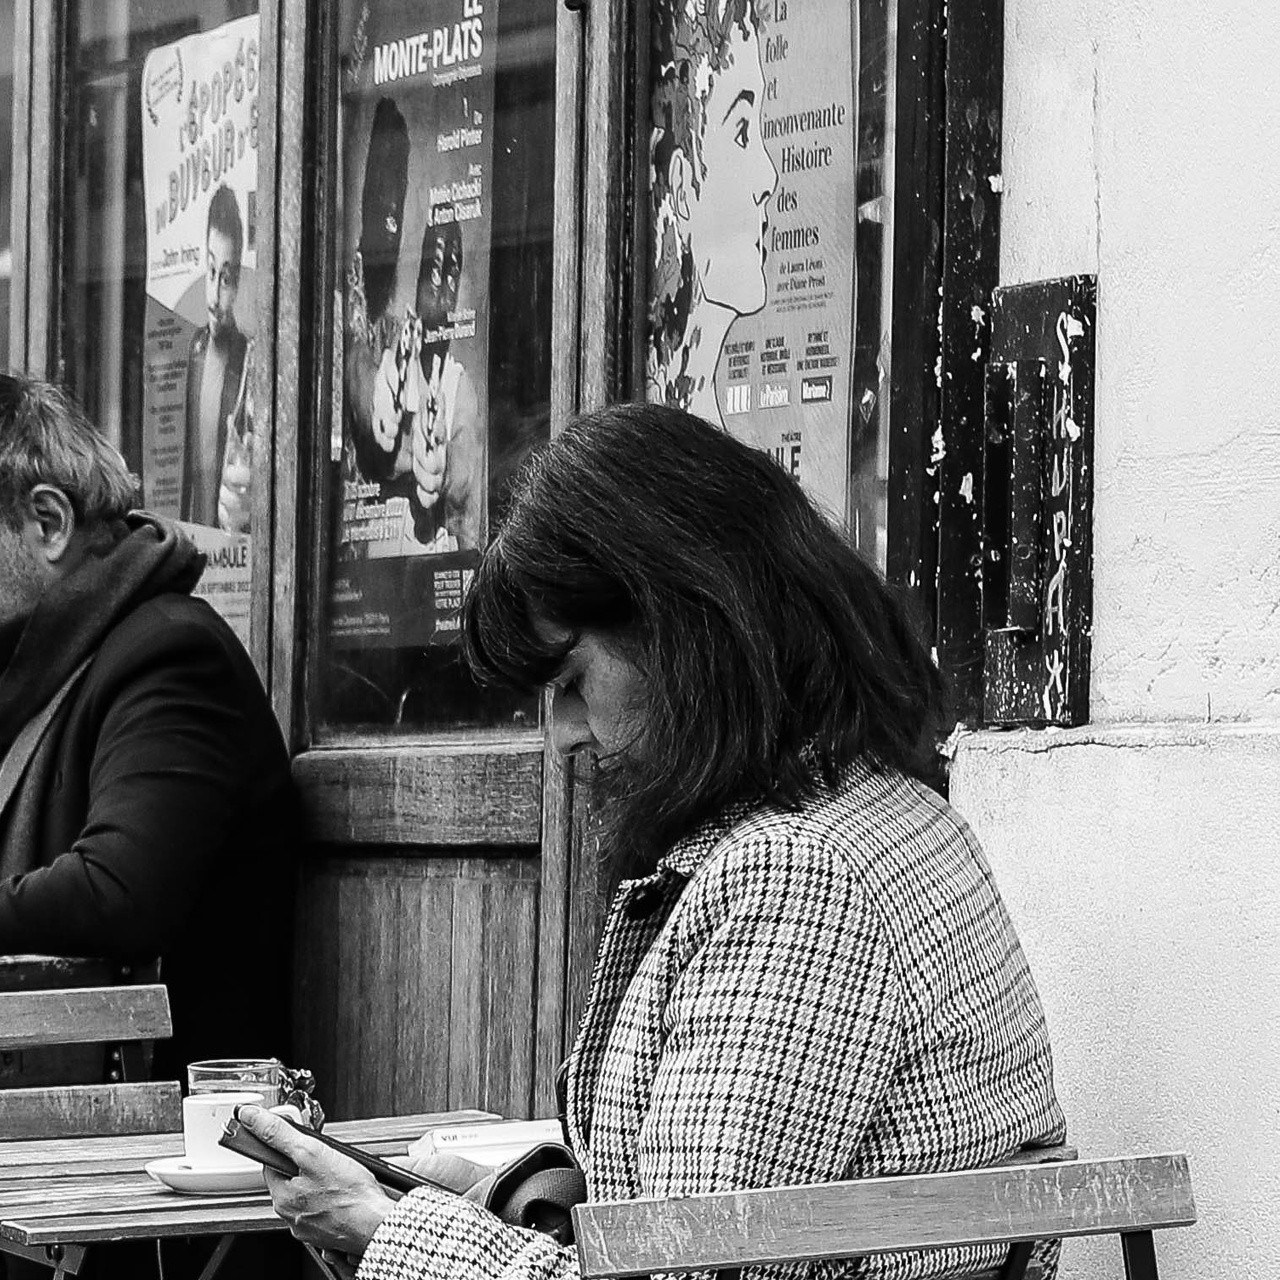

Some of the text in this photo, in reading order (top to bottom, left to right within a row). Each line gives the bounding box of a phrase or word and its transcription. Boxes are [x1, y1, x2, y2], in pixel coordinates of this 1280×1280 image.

[374, 18, 482, 85] MONTE-PLATS
[765, 34, 788, 63] folle
[767, 77, 777, 100] et
[763, 102, 845, 139] inconvenante
[782, 140, 832, 173] Histoire
[777, 186, 798, 213] des
[772, 226, 820, 252] femmes
